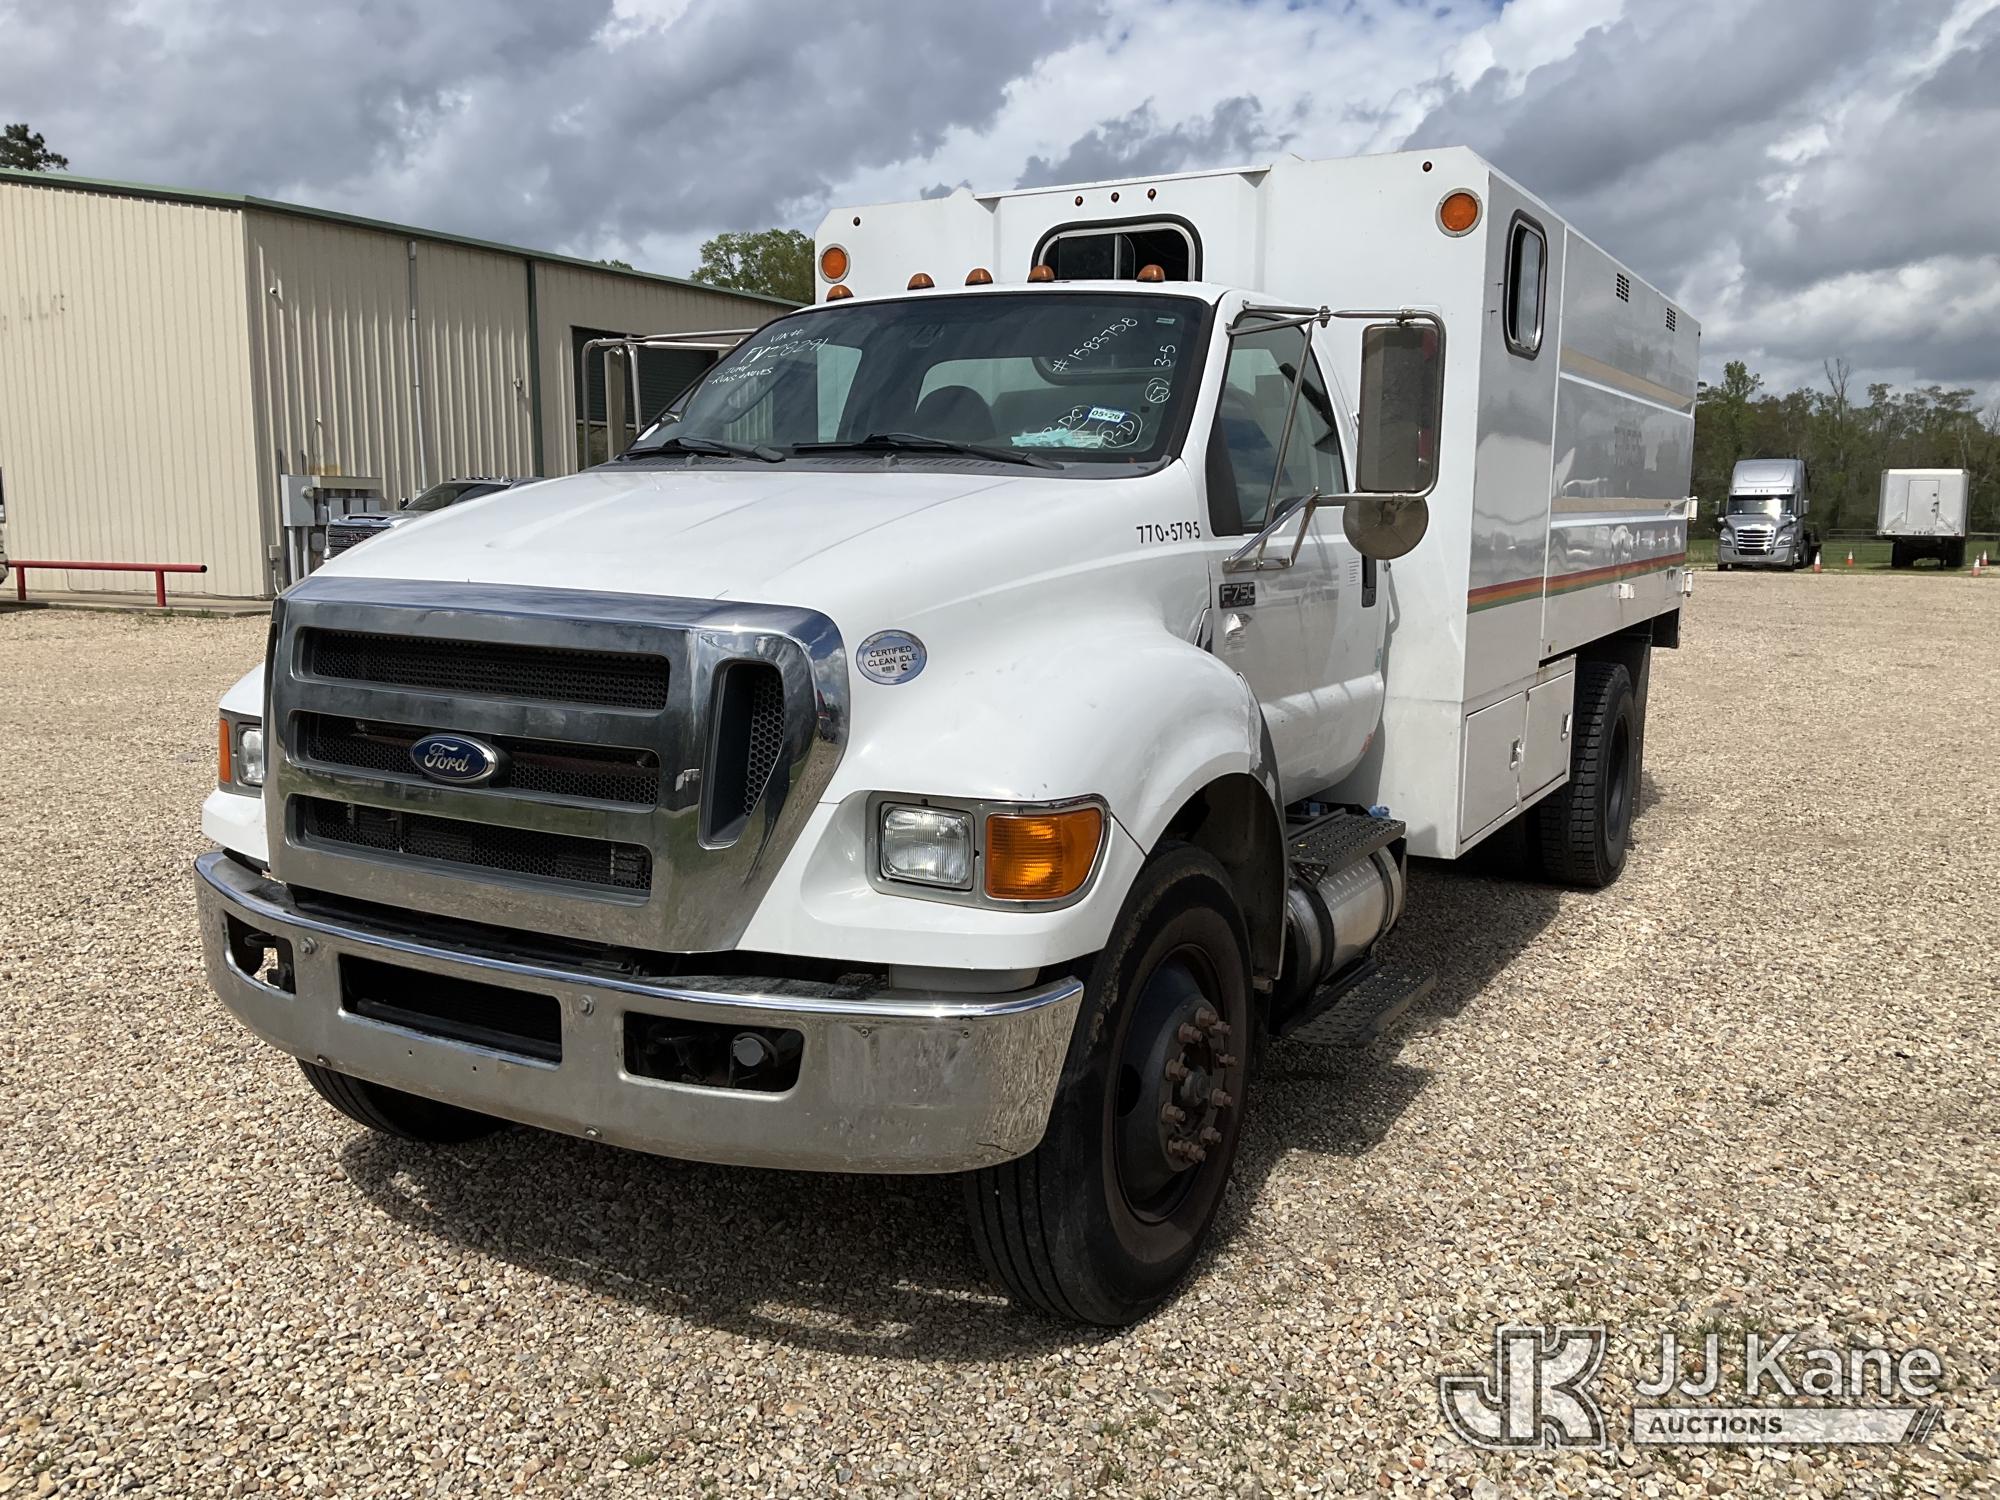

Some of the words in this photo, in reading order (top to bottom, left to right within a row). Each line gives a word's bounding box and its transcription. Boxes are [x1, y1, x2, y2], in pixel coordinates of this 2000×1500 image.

[1153, 344, 1176, 367] 3-5
[868, 656, 897, 667] CLEAN
[899, 653, 917, 663] IDLE
[870, 645, 911, 657] CERTIFIED
[424, 742, 470, 772] Ford
